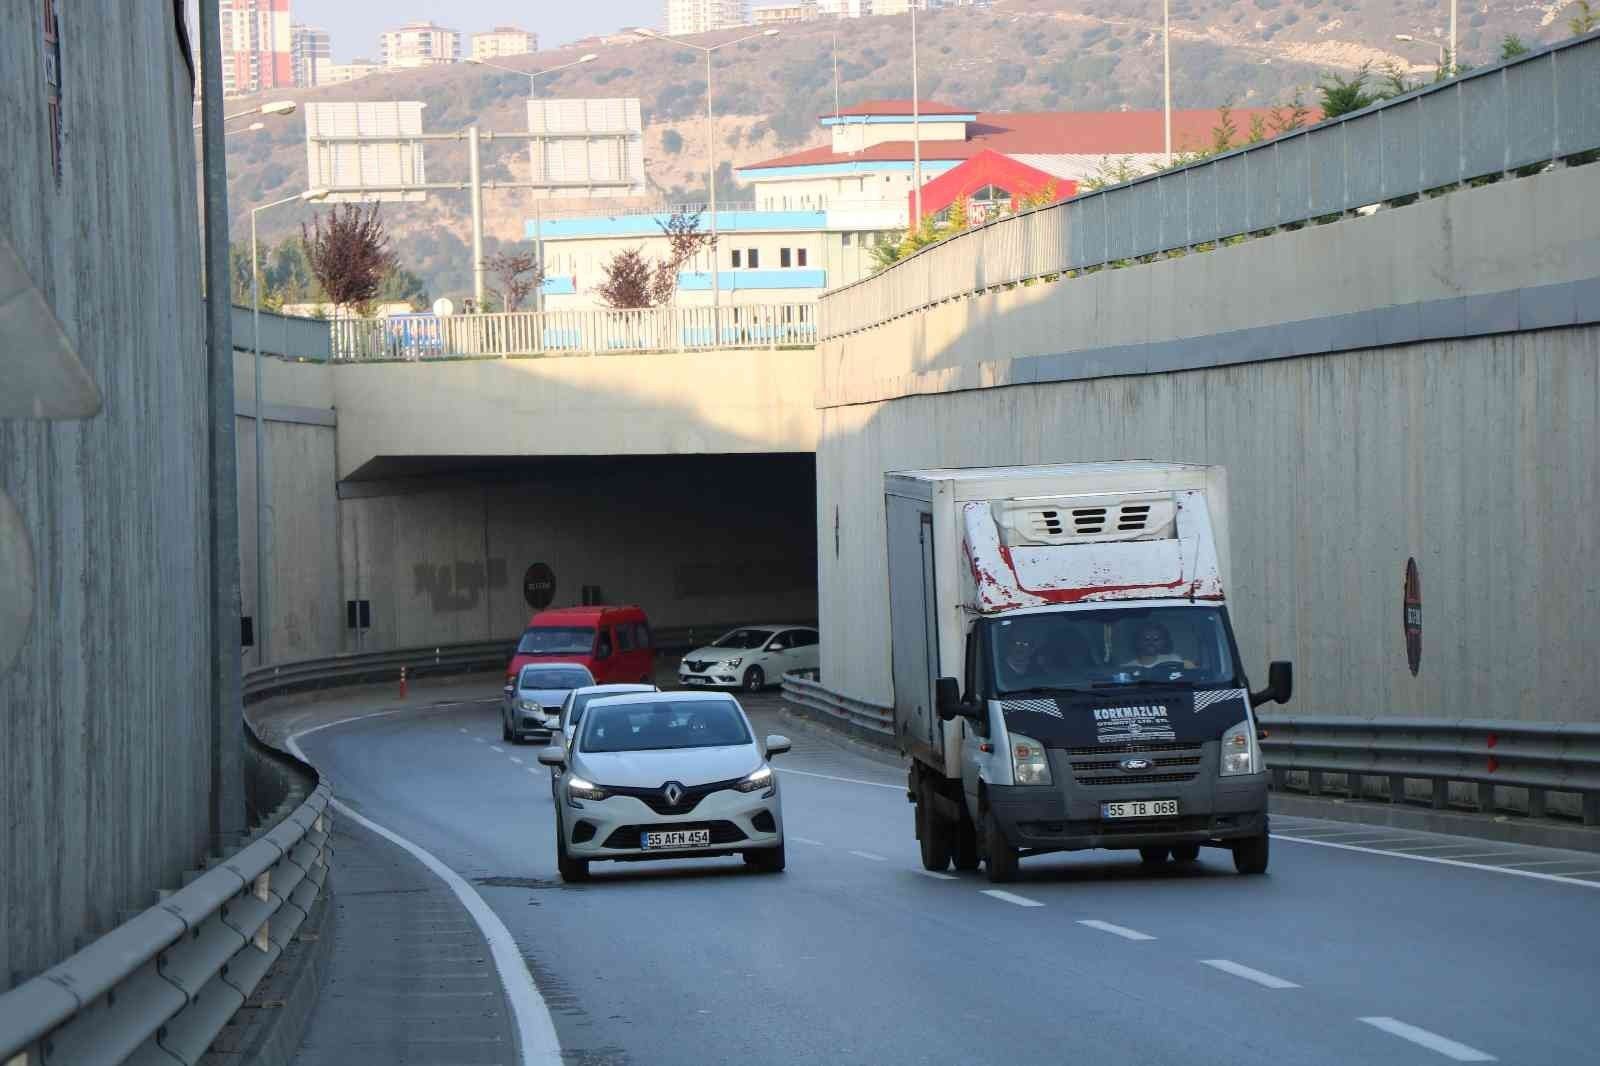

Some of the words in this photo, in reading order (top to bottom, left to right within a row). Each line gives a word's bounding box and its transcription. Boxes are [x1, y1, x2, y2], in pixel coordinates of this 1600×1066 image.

[1093, 705, 1168, 720] KORKMAZLAR
[1127, 760, 1147, 769] Ford
[1110, 804, 1124, 816] 55
[1132, 803, 1146, 815] TB
[1153, 801, 1176, 814] 068
[648, 833, 661, 845] 55
[665, 832, 685, 844] AFN
[688, 831, 708, 842] 454
